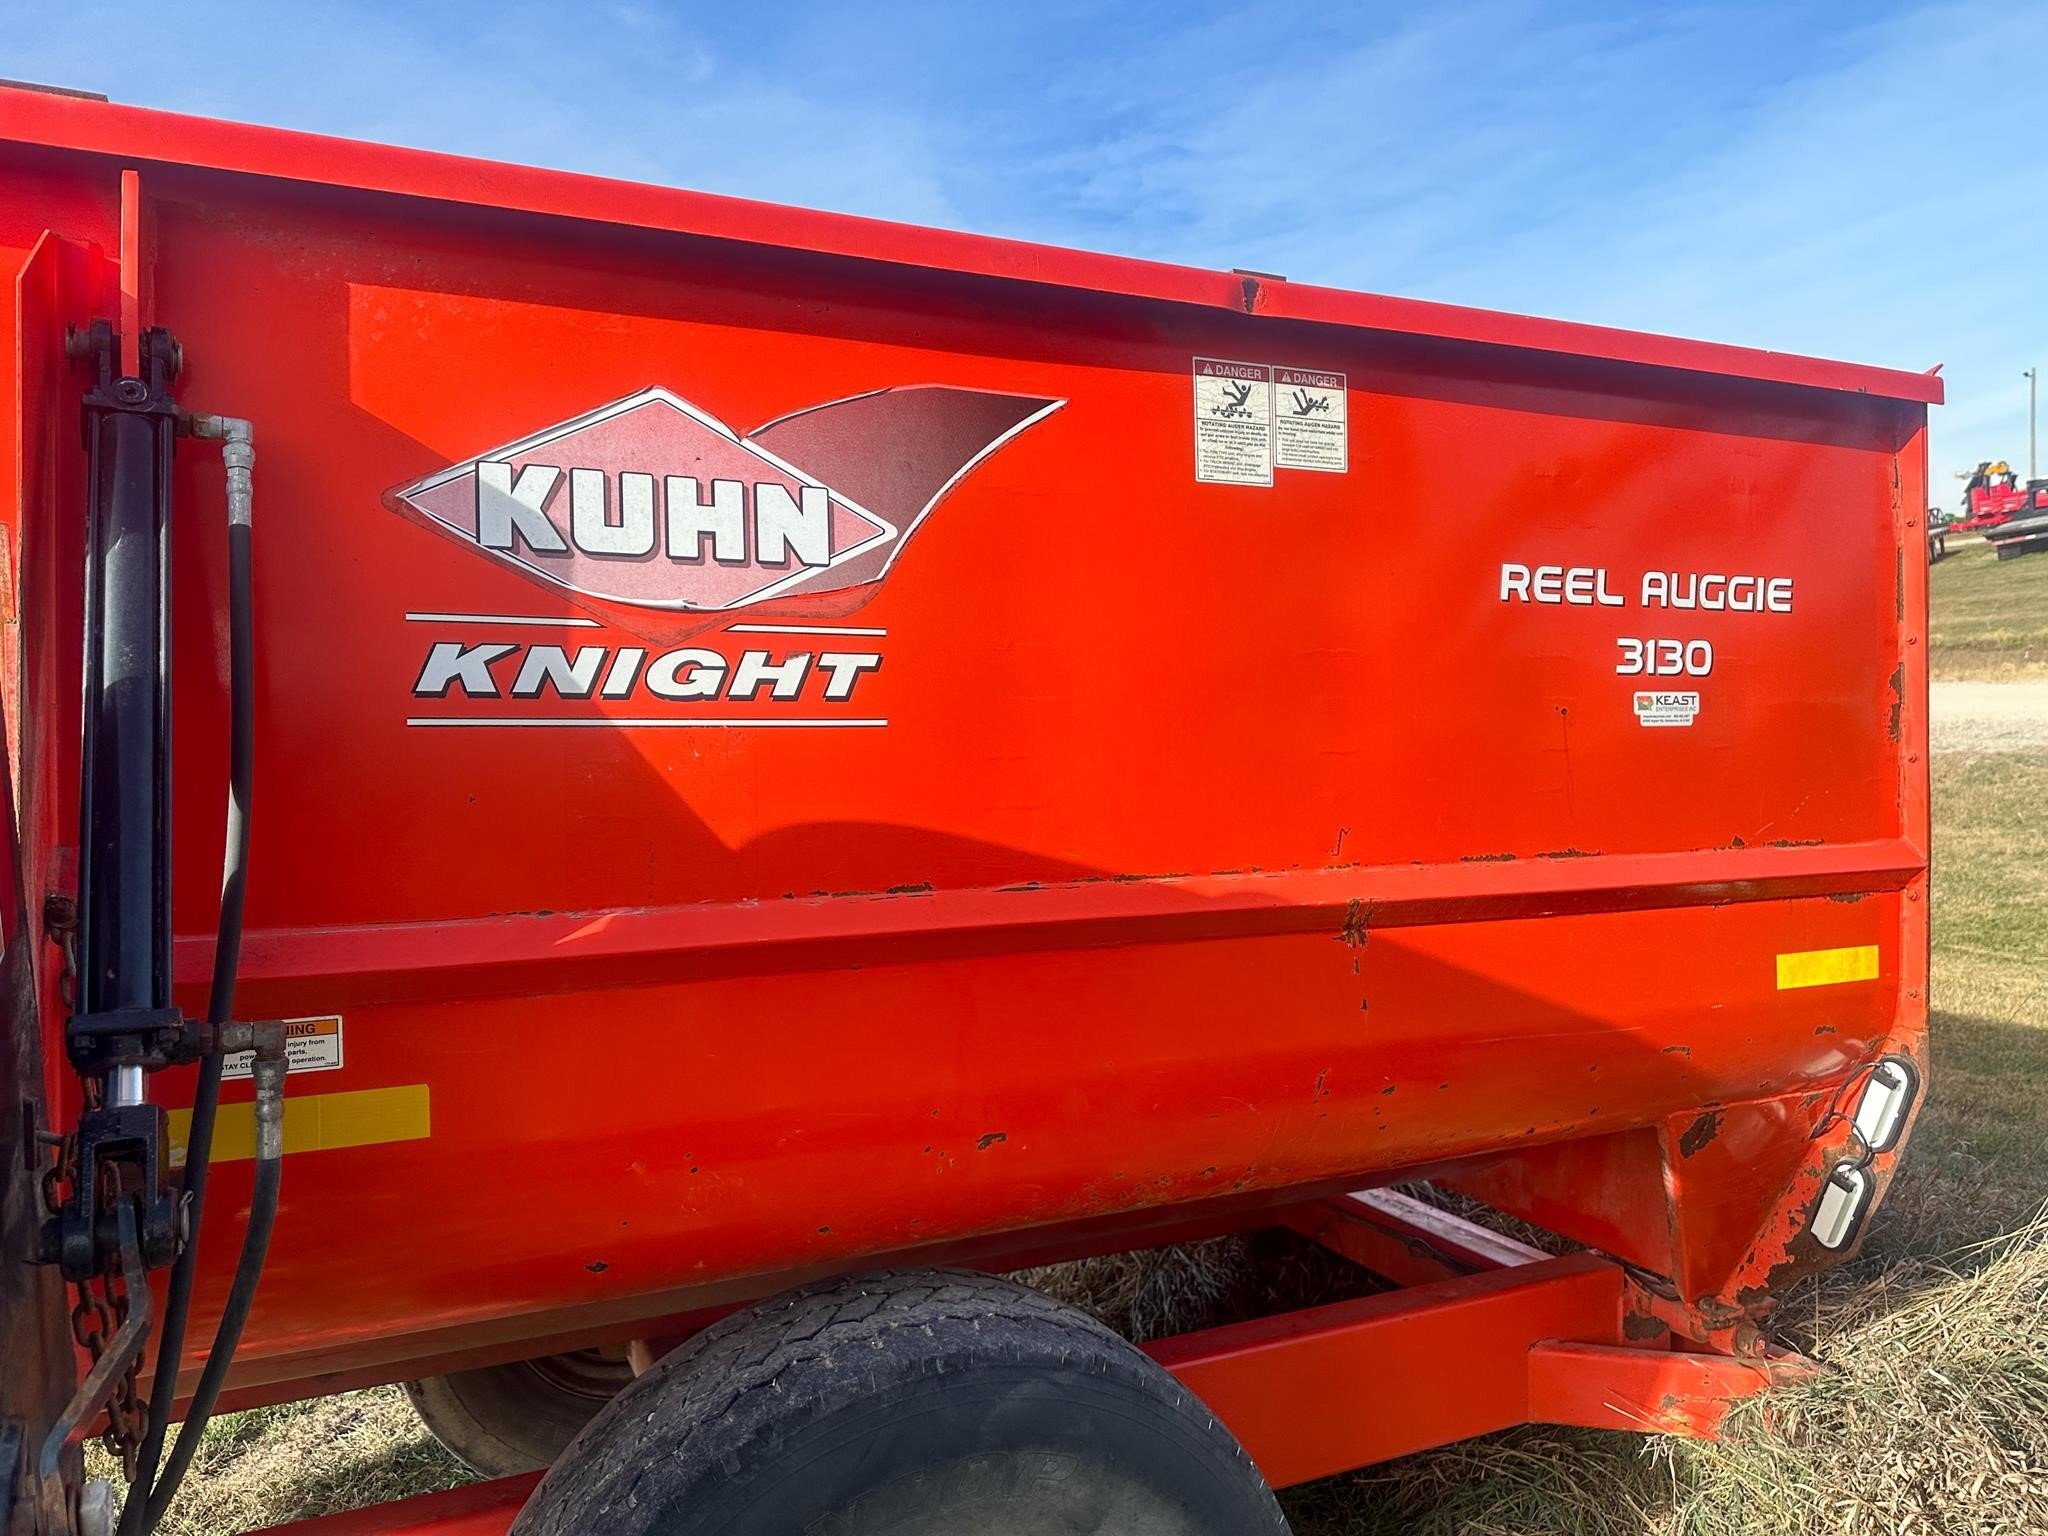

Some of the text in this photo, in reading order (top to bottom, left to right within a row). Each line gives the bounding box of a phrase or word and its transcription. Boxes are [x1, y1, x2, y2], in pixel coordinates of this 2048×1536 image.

[1215, 364, 1262, 380] DANGER
[1293, 372, 1337, 387] DANGER
[475, 460, 832, 567] KUHN
[1499, 562, 1794, 613] REEL AUGGIE
[1615, 637, 1713, 677] 3130
[410, 641, 884, 702] KNIGHT
[1656, 695, 1697, 705] KEAST
[286, 1023, 316, 1036] ING
[291, 1056, 327, 1064] operation.
